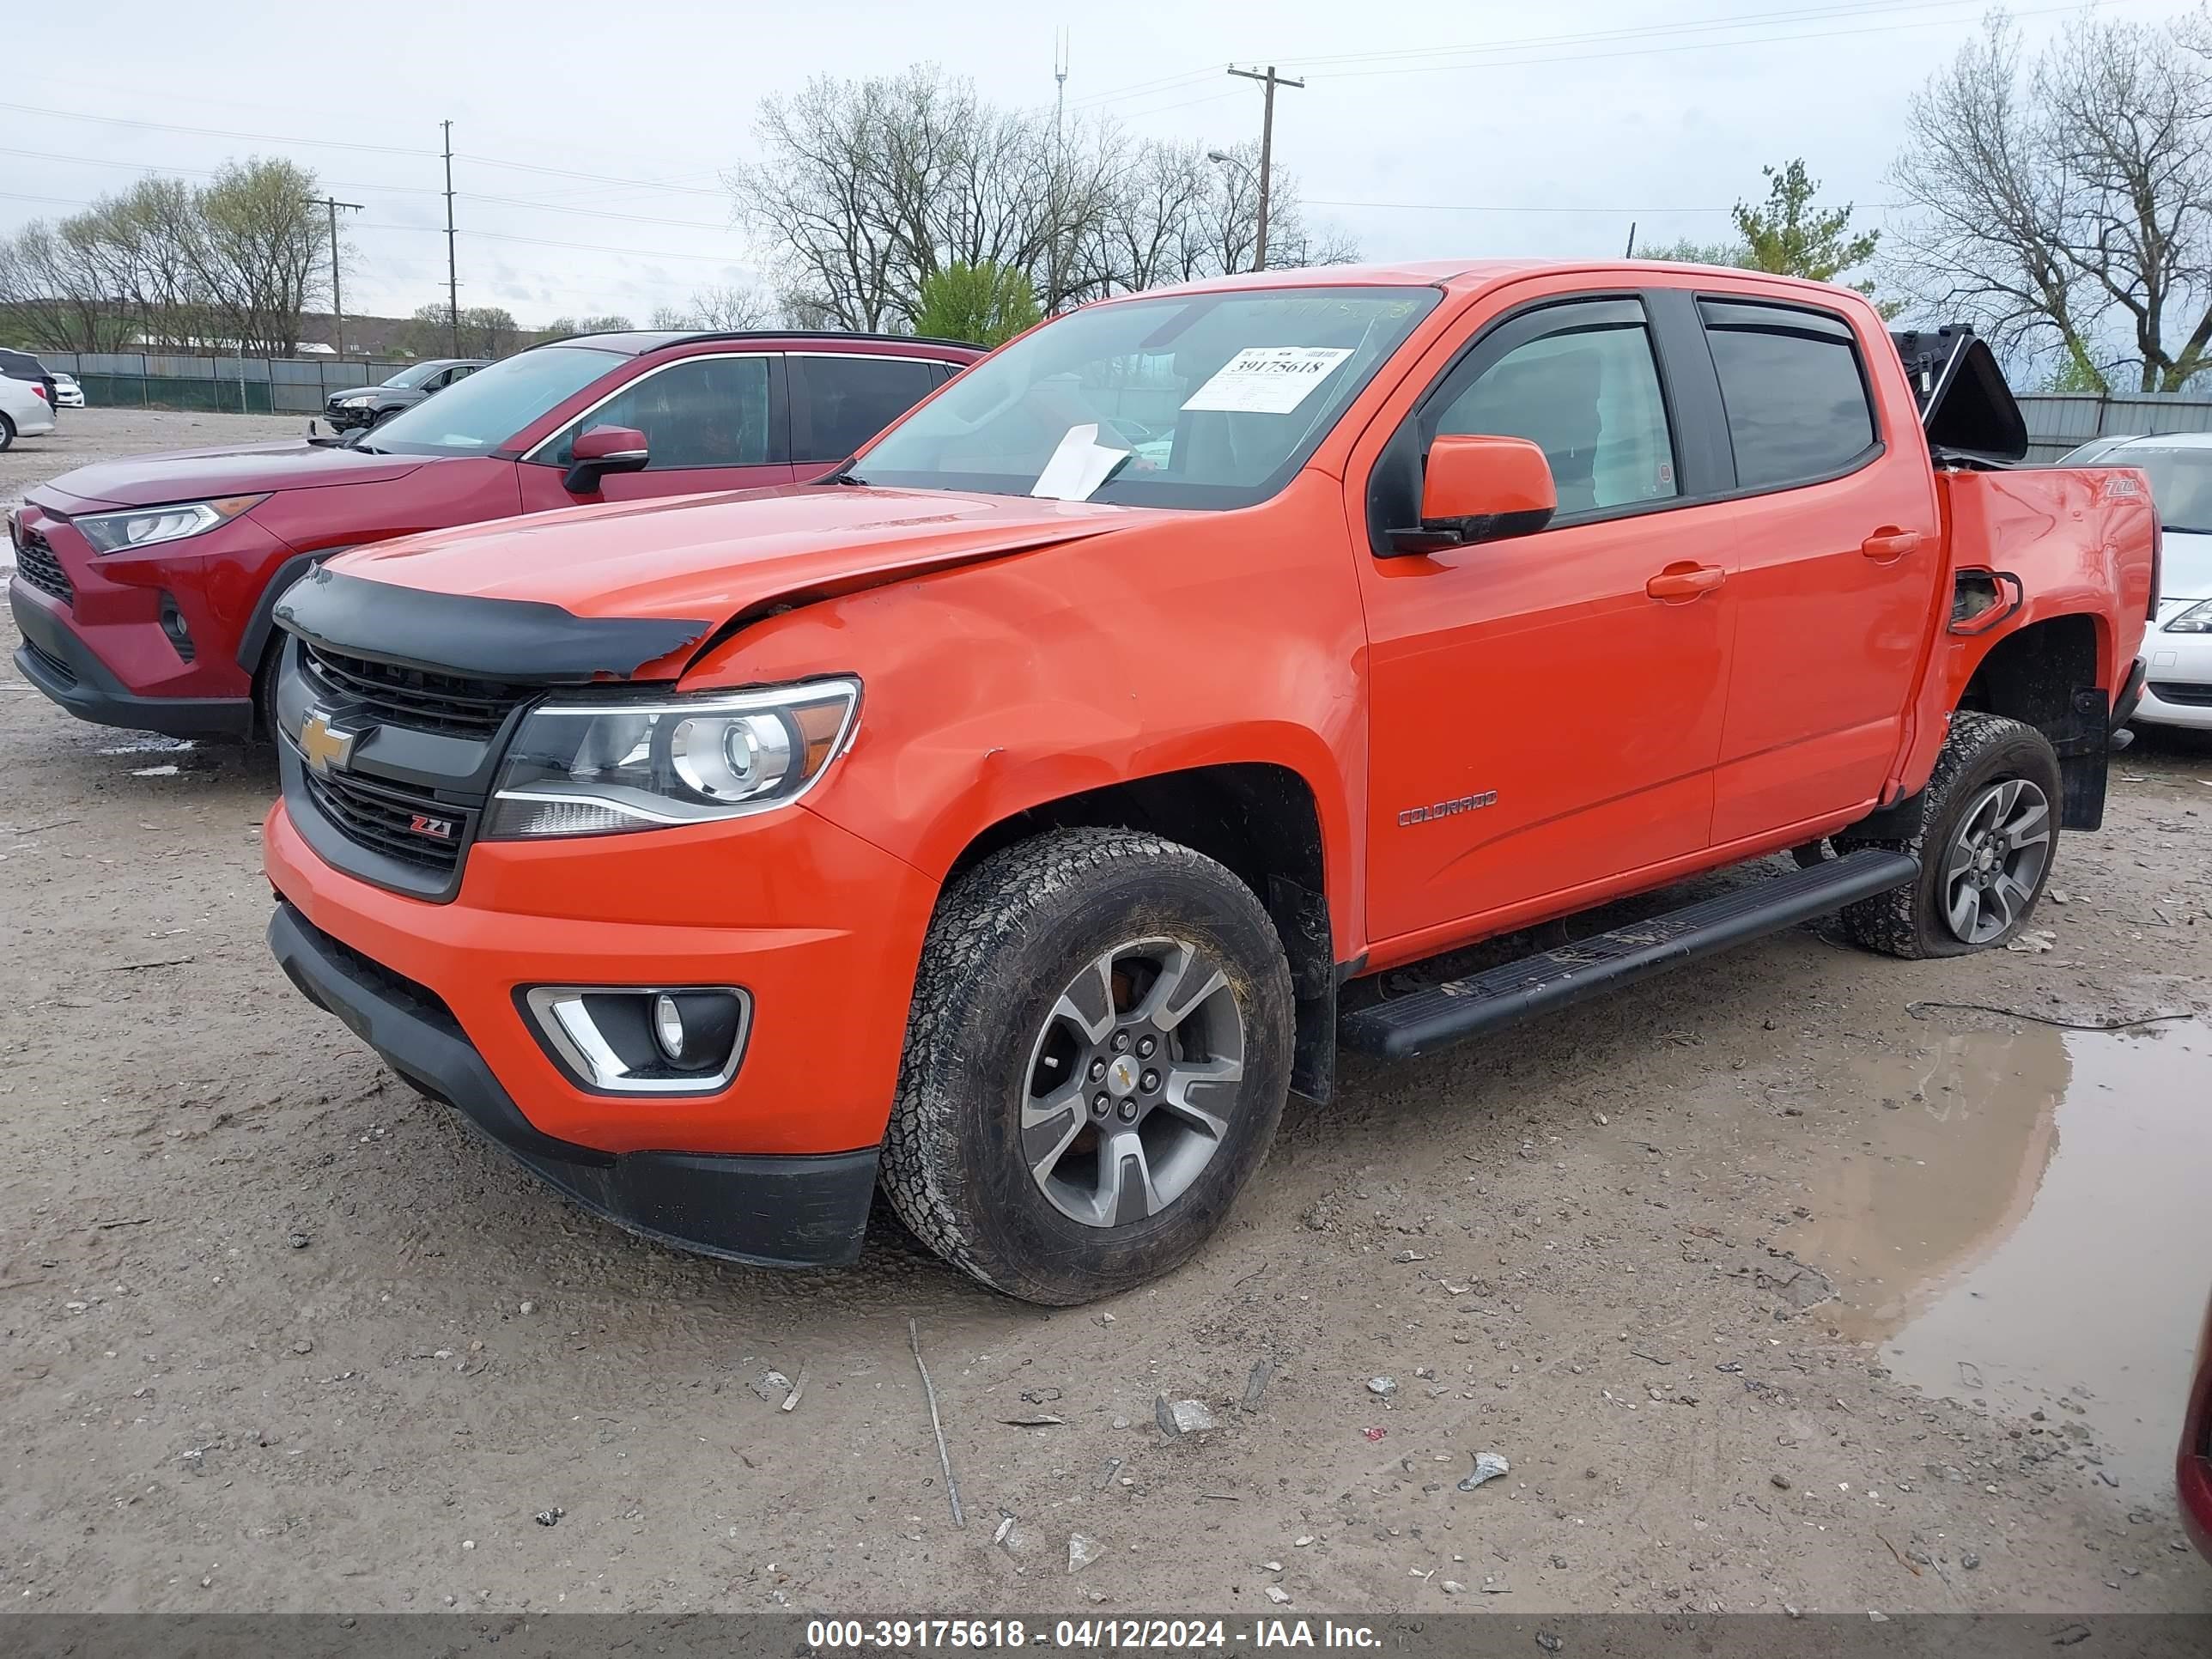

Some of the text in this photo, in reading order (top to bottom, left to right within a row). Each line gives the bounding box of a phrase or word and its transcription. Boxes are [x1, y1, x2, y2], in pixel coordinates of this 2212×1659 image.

[1231, 361, 1325, 374] 39175618
[2105, 479, 2140, 497] Z71
[1399, 790, 1498, 826] COLORADO
[410, 814, 452, 838] Z71
